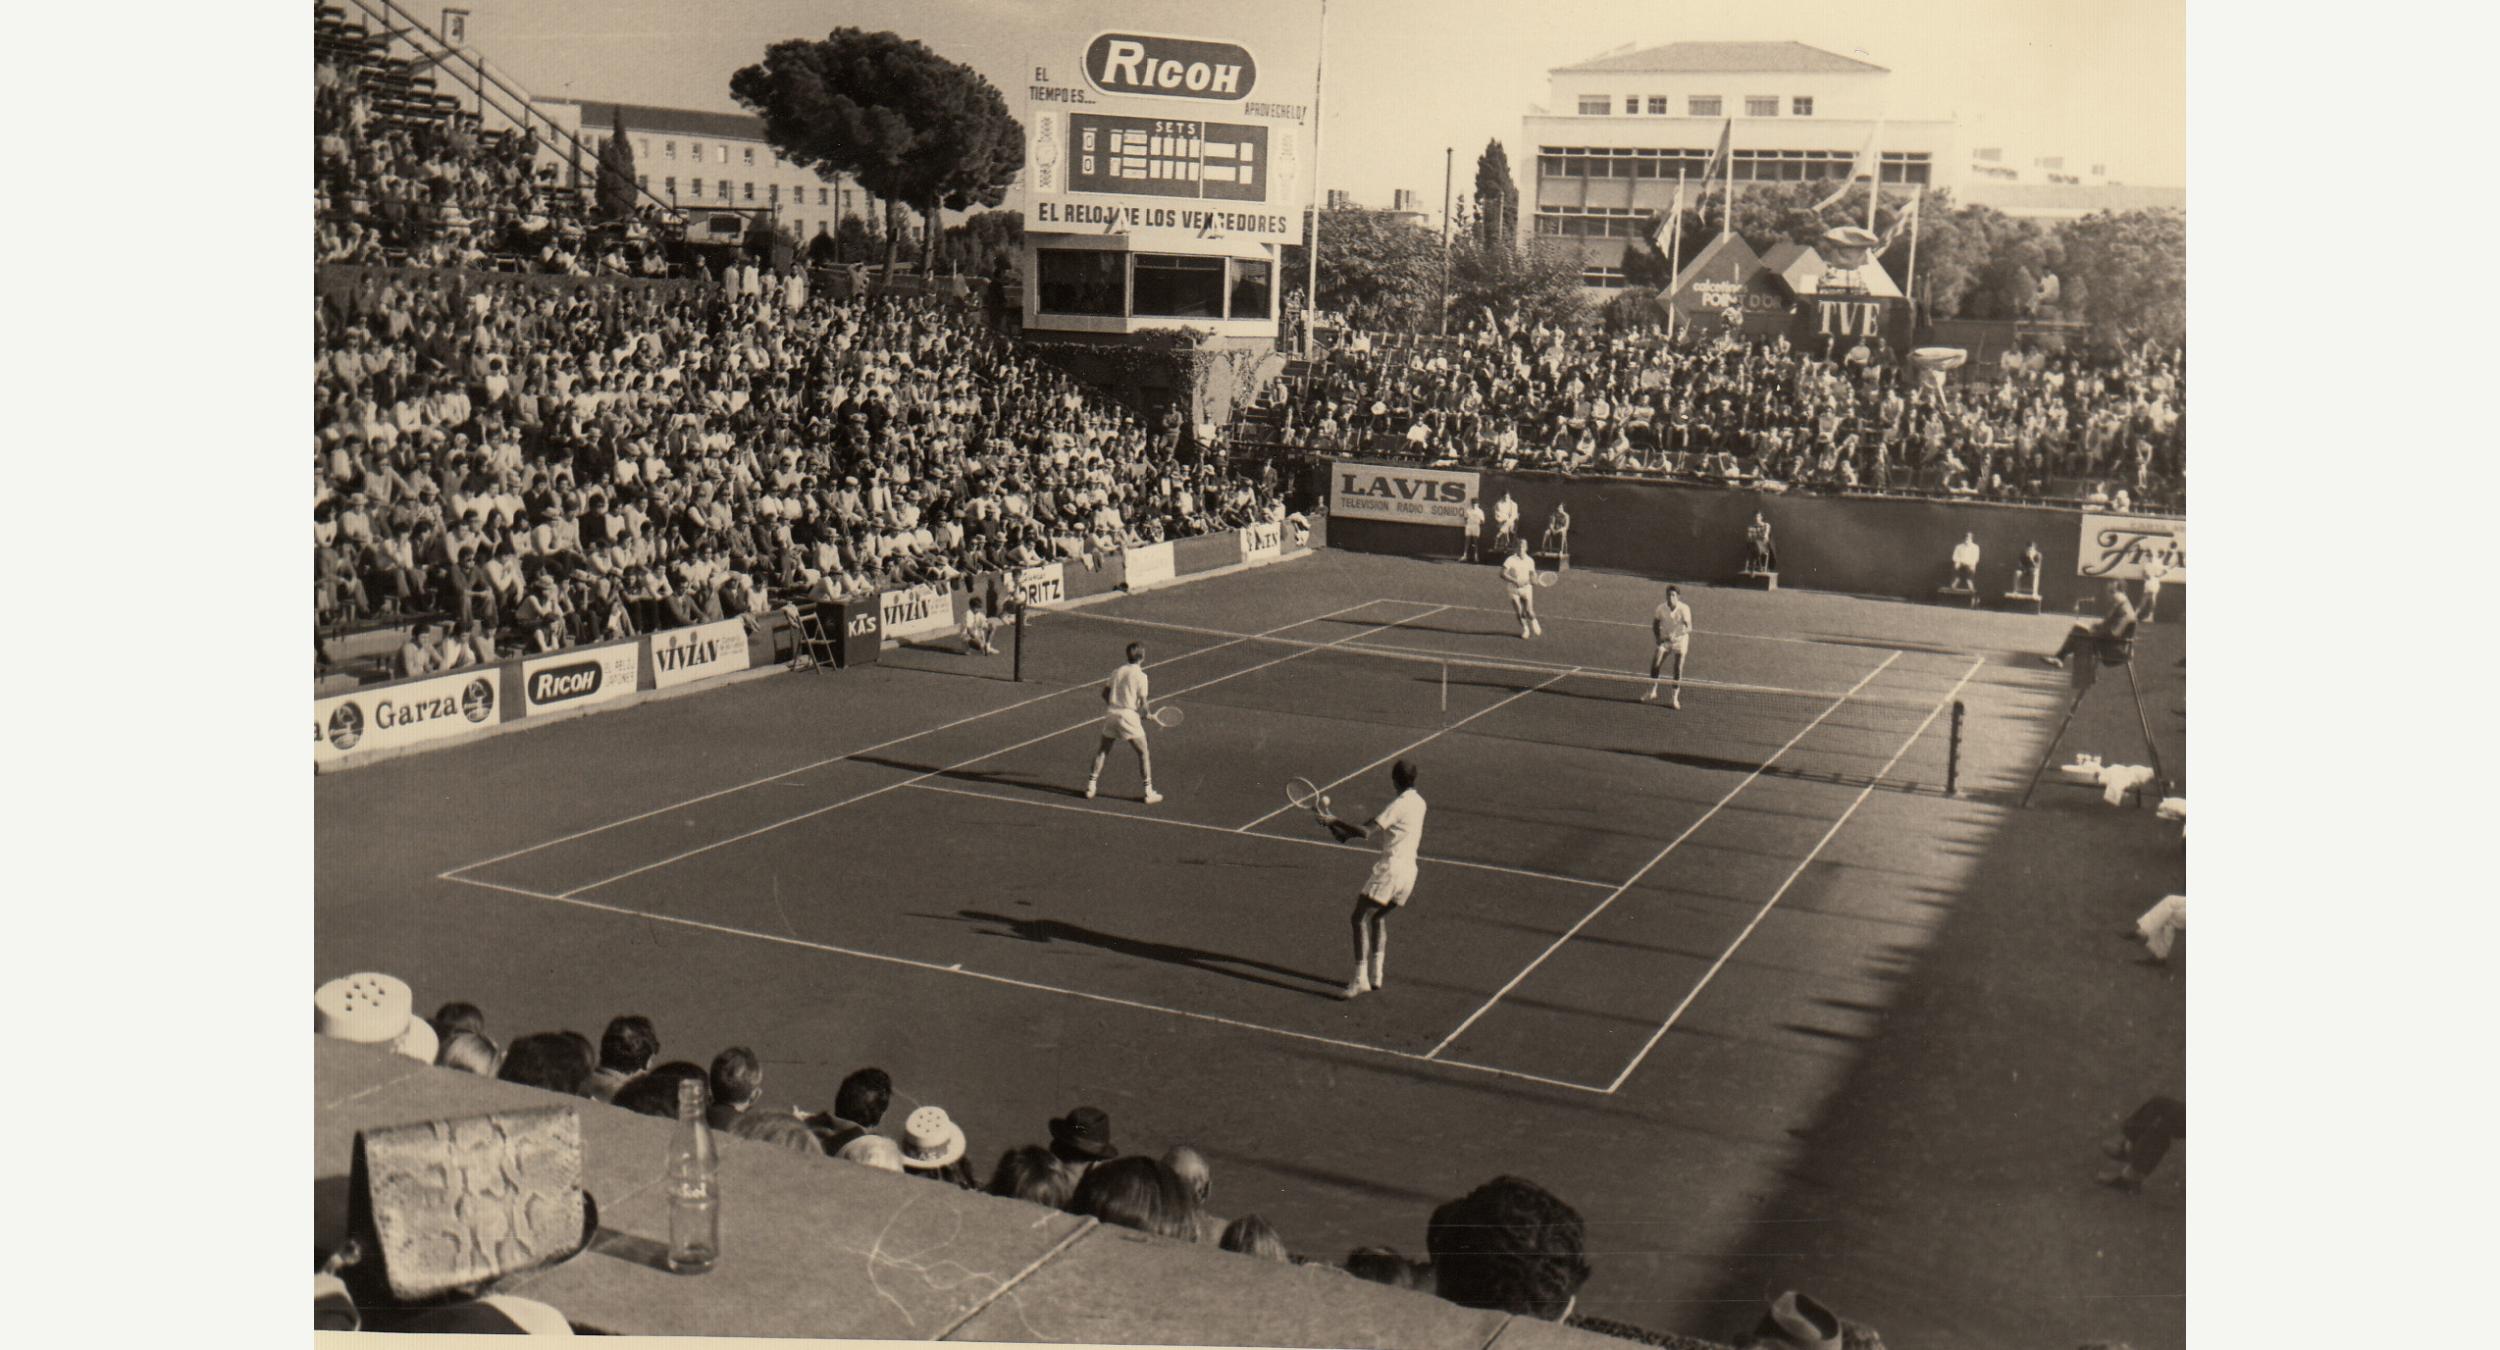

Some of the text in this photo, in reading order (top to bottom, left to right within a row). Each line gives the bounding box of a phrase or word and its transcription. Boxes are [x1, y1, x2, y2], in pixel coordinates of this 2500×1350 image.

[1035, 67, 1049, 81] EL
[1101, 40, 1242, 94] RICOH
[1029, 86, 1069, 103] TIEMPO
[1155, 121, 1196, 136] SETS
[1039, 202, 1059, 222] EL
[1065, 204, 1113, 225] RELOJ
[1146, 208, 1176, 228] LOS
[1818, 300, 1880, 337] TVE
[1341, 474, 1466, 504] LAVIS
[1341, 498, 1390, 512] TELEVISION
[1397, 502, 1424, 515] RADIO
[536, 670, 597, 700] RICOH
[375, 696, 459, 730] Garza
